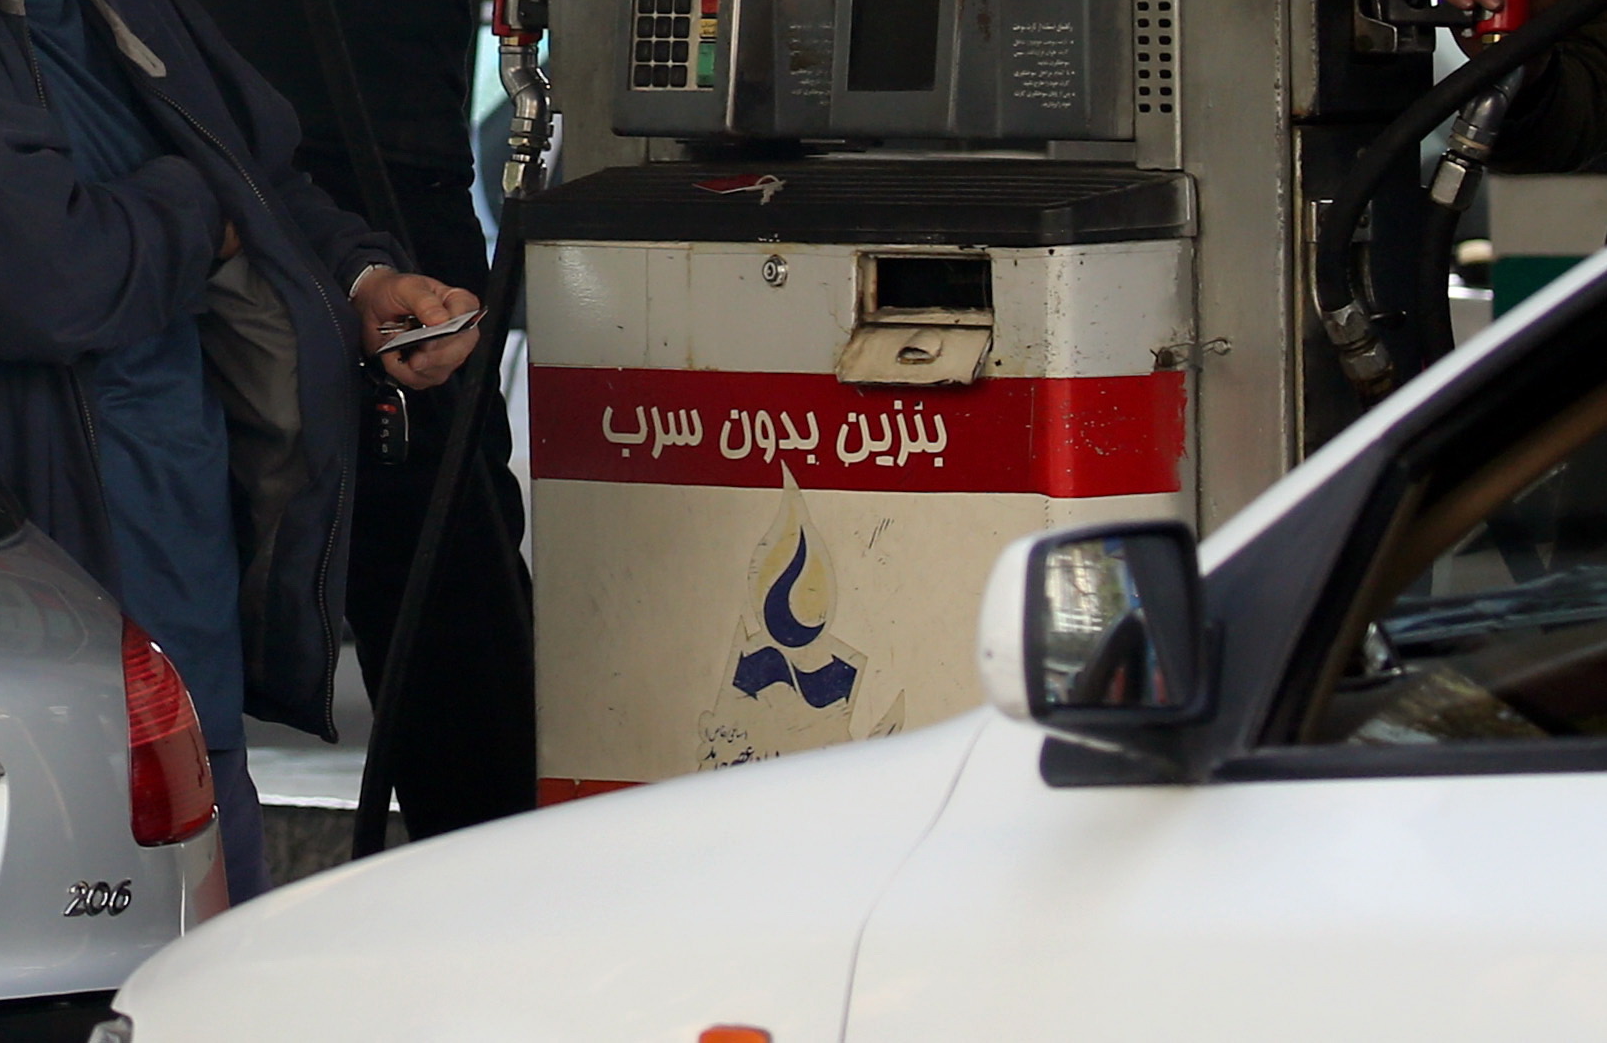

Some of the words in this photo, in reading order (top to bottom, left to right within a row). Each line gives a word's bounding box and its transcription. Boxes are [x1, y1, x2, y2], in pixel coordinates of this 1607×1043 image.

[602, 406, 703, 458] سرب
[720, 406, 819, 464] بدون
[836, 400, 948, 466] بنزین
[63, 878, 133, 919] 206
